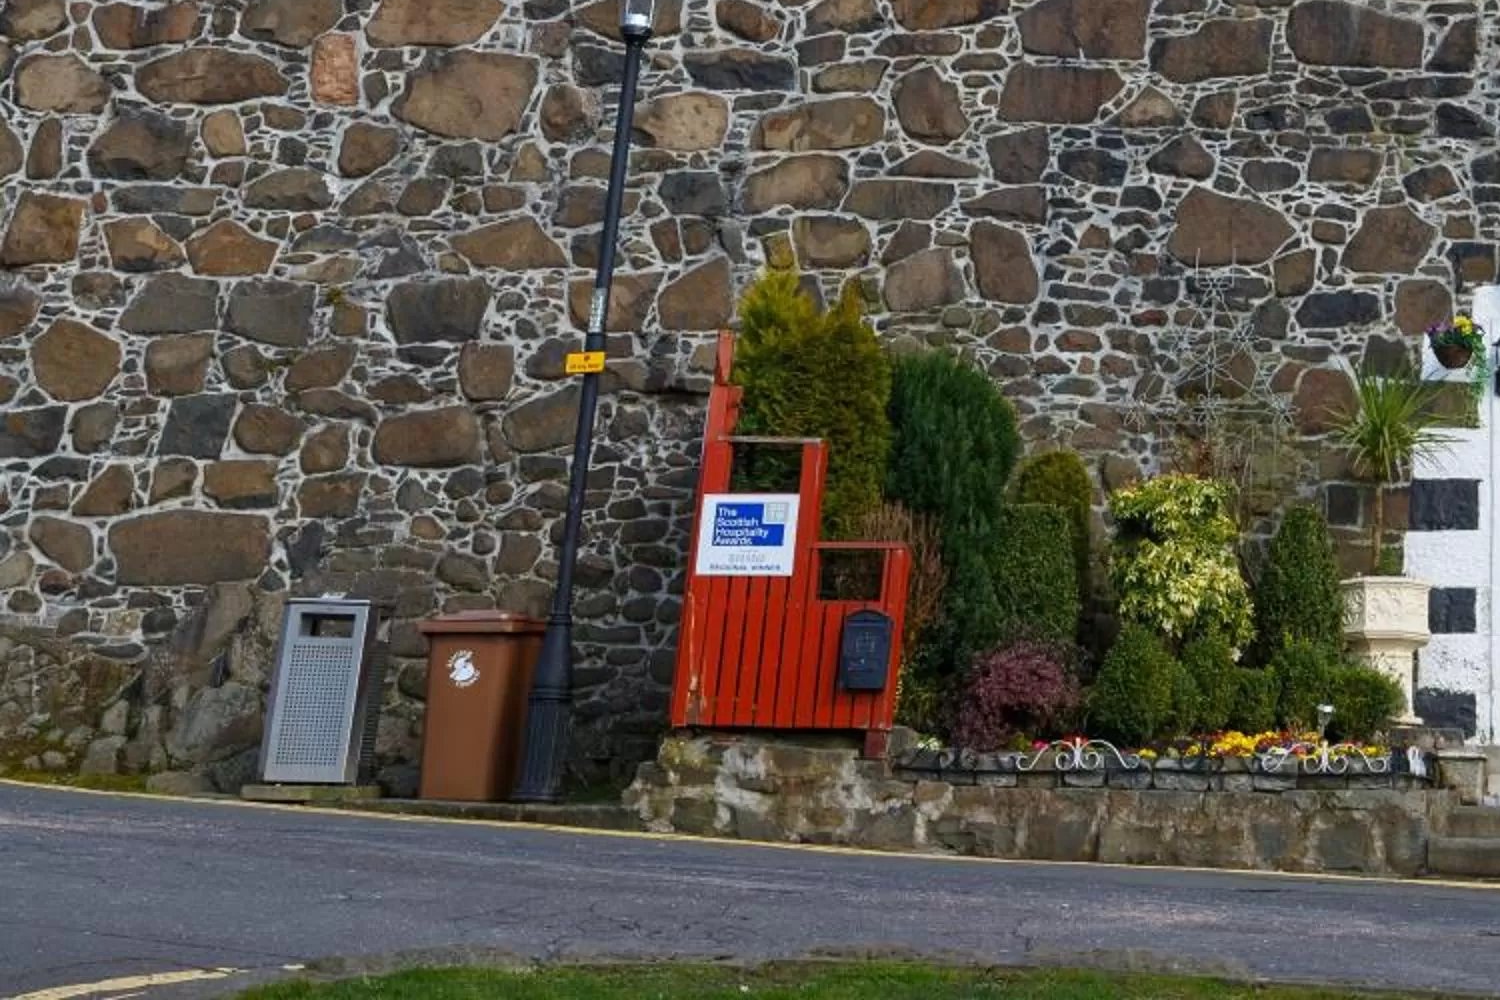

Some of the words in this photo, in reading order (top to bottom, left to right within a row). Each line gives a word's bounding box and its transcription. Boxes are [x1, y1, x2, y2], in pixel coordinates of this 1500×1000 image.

[718, 507, 738, 517] The
[716, 517, 759, 527] Scottish
[715, 527, 769, 538] Hospitality
